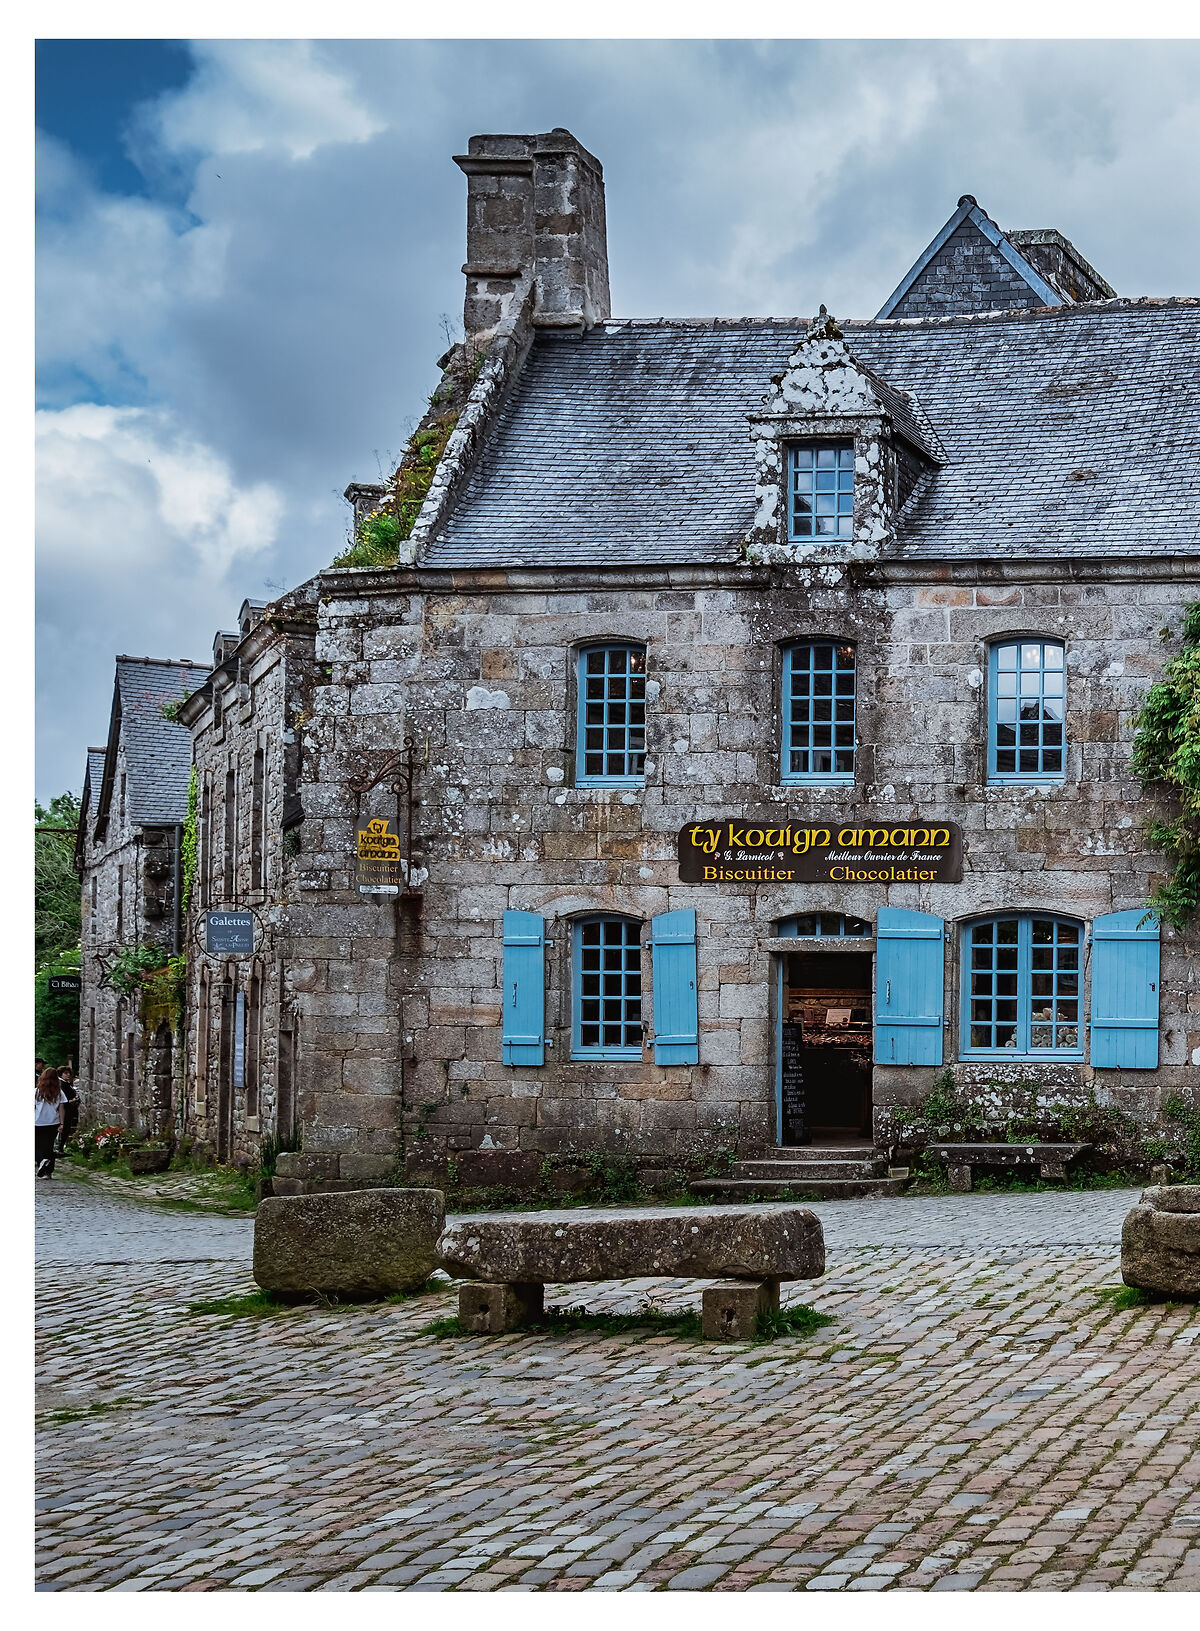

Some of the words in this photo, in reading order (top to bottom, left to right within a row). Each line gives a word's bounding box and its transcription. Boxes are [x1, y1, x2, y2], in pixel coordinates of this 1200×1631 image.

[371, 822, 384, 834] ty
[688, 825, 722, 854] ty
[728, 823, 831, 854] kouign
[837, 827, 950, 848] amann
[735, 849, 775, 861] Larnicol
[823, 850, 863, 861] Meilleur
[863, 850, 896, 861] Ouvrier
[896, 850, 908, 861] de
[909, 850, 942, 861] France
[359, 863, 398, 873] Biscuitier
[703, 865, 796, 880] Biscuitier
[829, 865, 938, 881] Chocolatier
[355, 874, 402, 884] Chocolatier
[209, 916, 251, 927] Galettes
